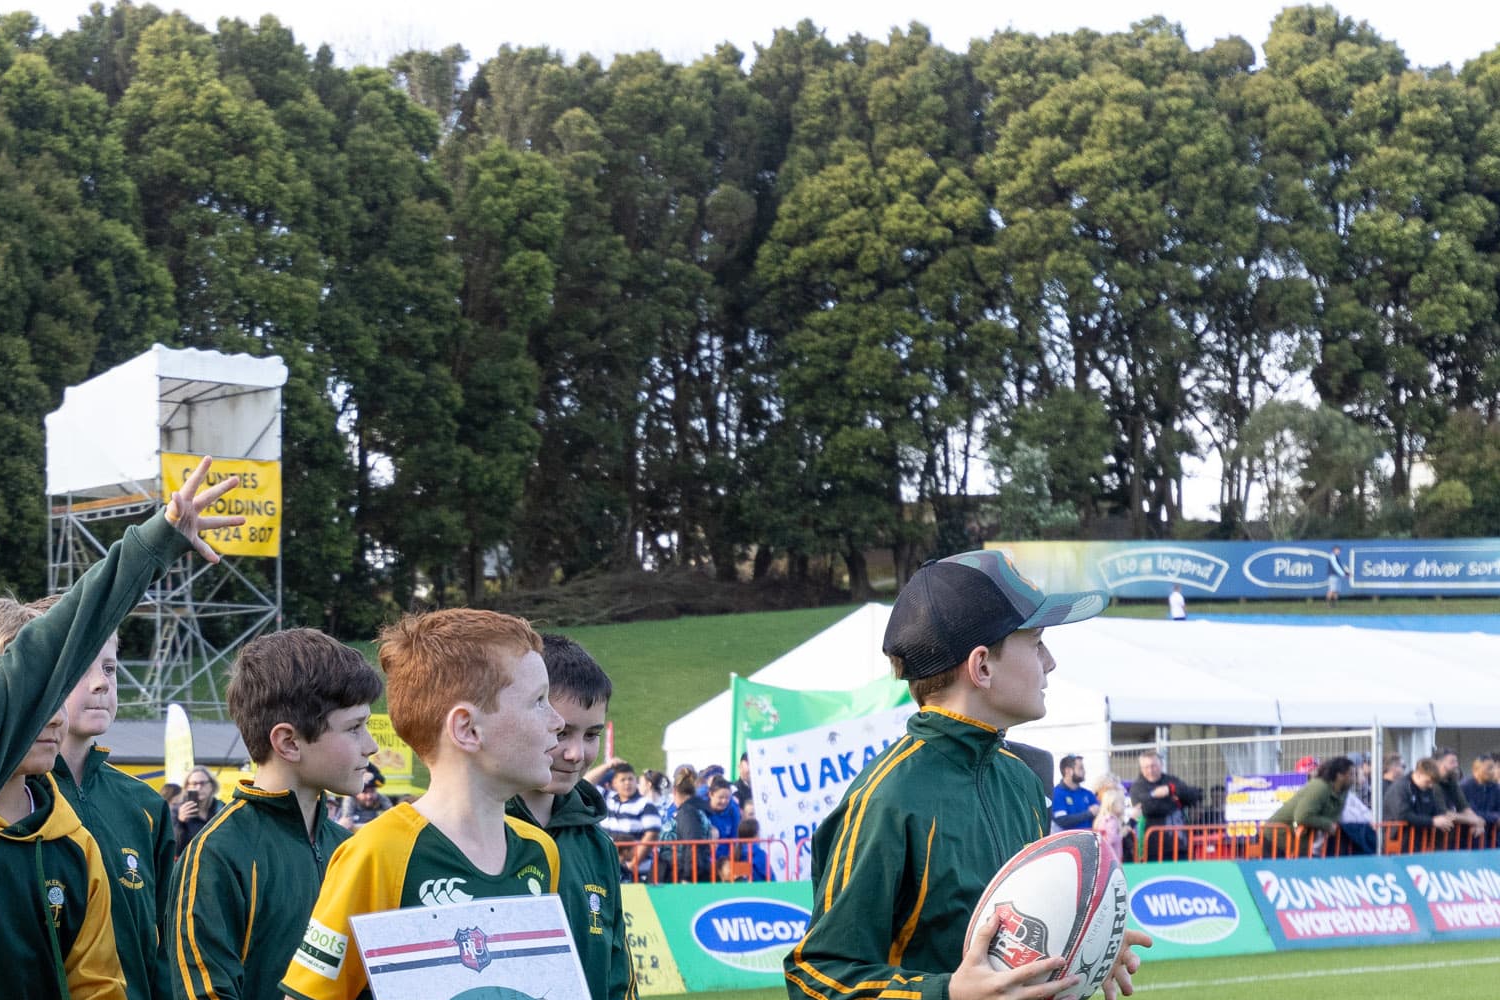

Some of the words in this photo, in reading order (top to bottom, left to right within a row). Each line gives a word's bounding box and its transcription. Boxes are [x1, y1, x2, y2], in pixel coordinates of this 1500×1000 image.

[248, 526, 275, 543] 807
[1156, 554, 1215, 581] legend
[1274, 557, 1314, 577] Plan
[1362, 559, 1409, 578] Sober
[1413, 558, 1465, 578] driver
[1467, 559, 1500, 577] sort
[367, 719, 389, 730] RESH
[1255, 870, 1408, 911] BUNNINGS
[1143, 892, 1221, 918] Wilcox
[711, 916, 807, 942] Wilcox
[1285, 902, 1411, 938] warehouse
